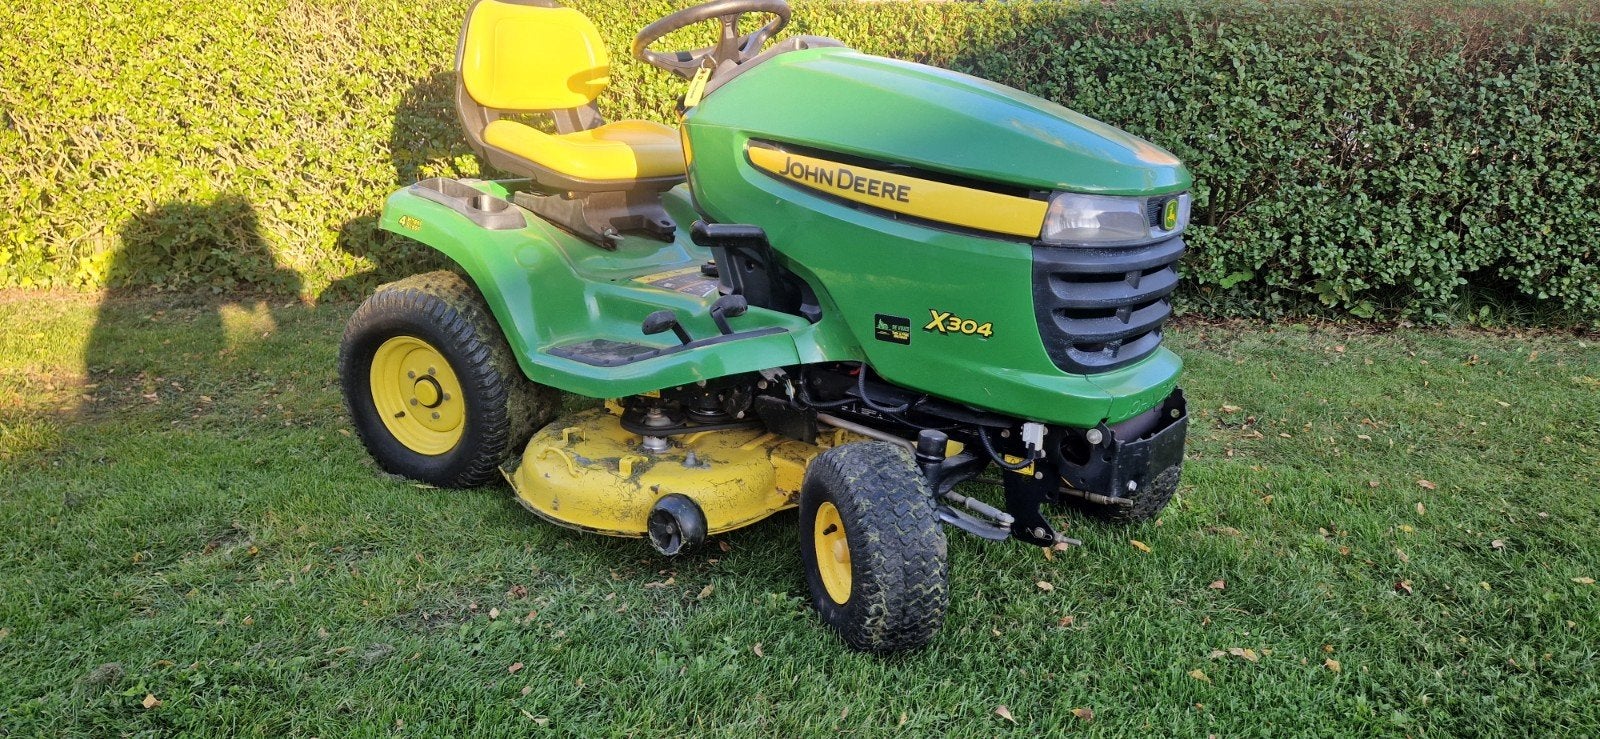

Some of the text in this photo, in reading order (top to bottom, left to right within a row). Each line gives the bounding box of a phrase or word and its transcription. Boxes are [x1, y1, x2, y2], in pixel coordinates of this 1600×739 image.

[779, 157, 910, 202] JOHN DEERE
[923, 308, 994, 338] X304
